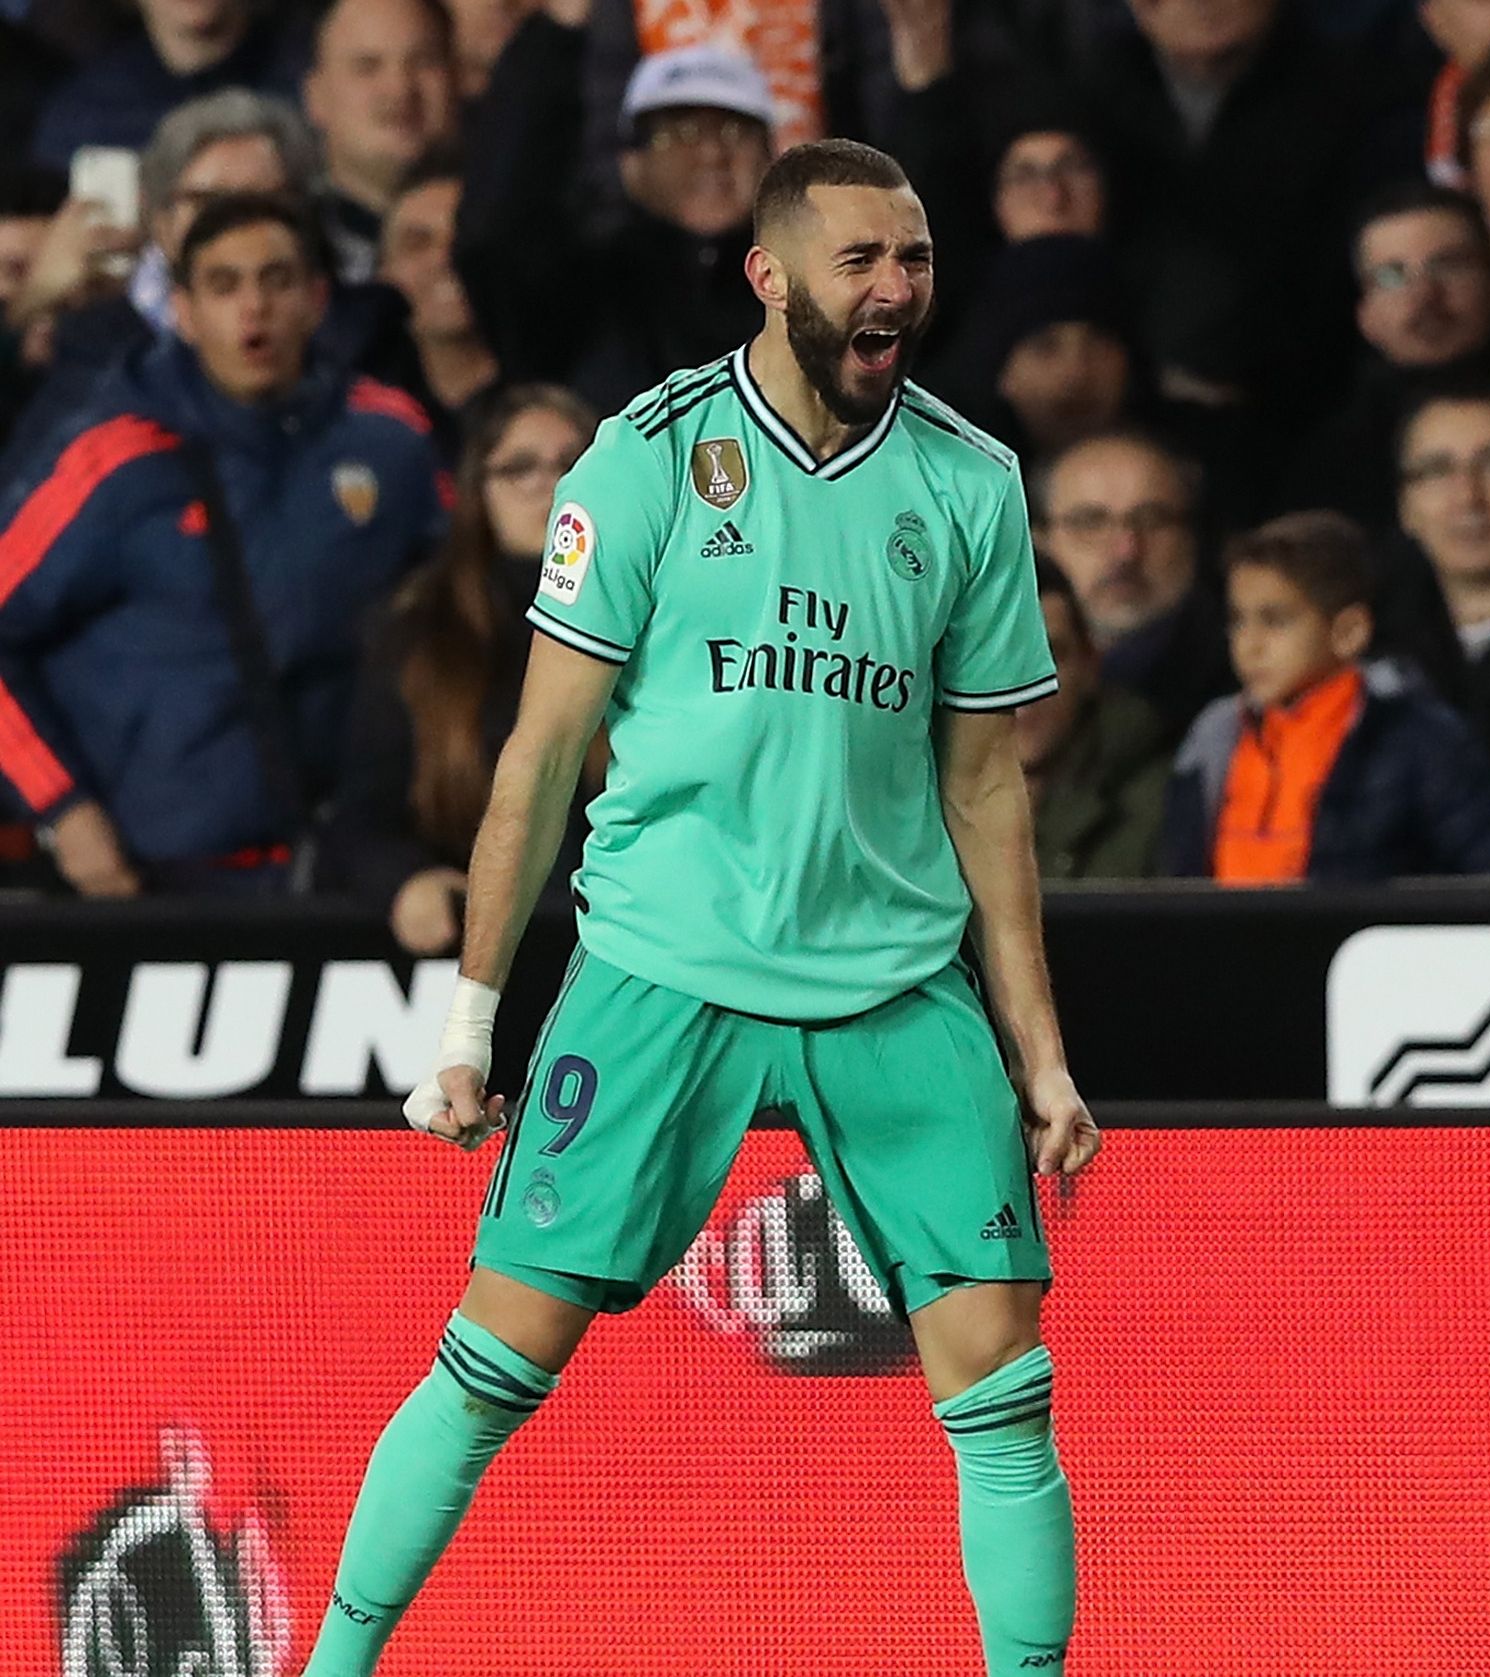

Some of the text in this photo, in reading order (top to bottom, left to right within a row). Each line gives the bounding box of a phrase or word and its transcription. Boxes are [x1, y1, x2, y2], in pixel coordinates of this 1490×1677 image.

[708, 482, 735, 495] FIFA
[700, 542, 754, 558] adidas
[778, 584, 849, 641] Fly
[705, 631, 915, 713] Emirates
[538, 1053, 599, 1159] 9
